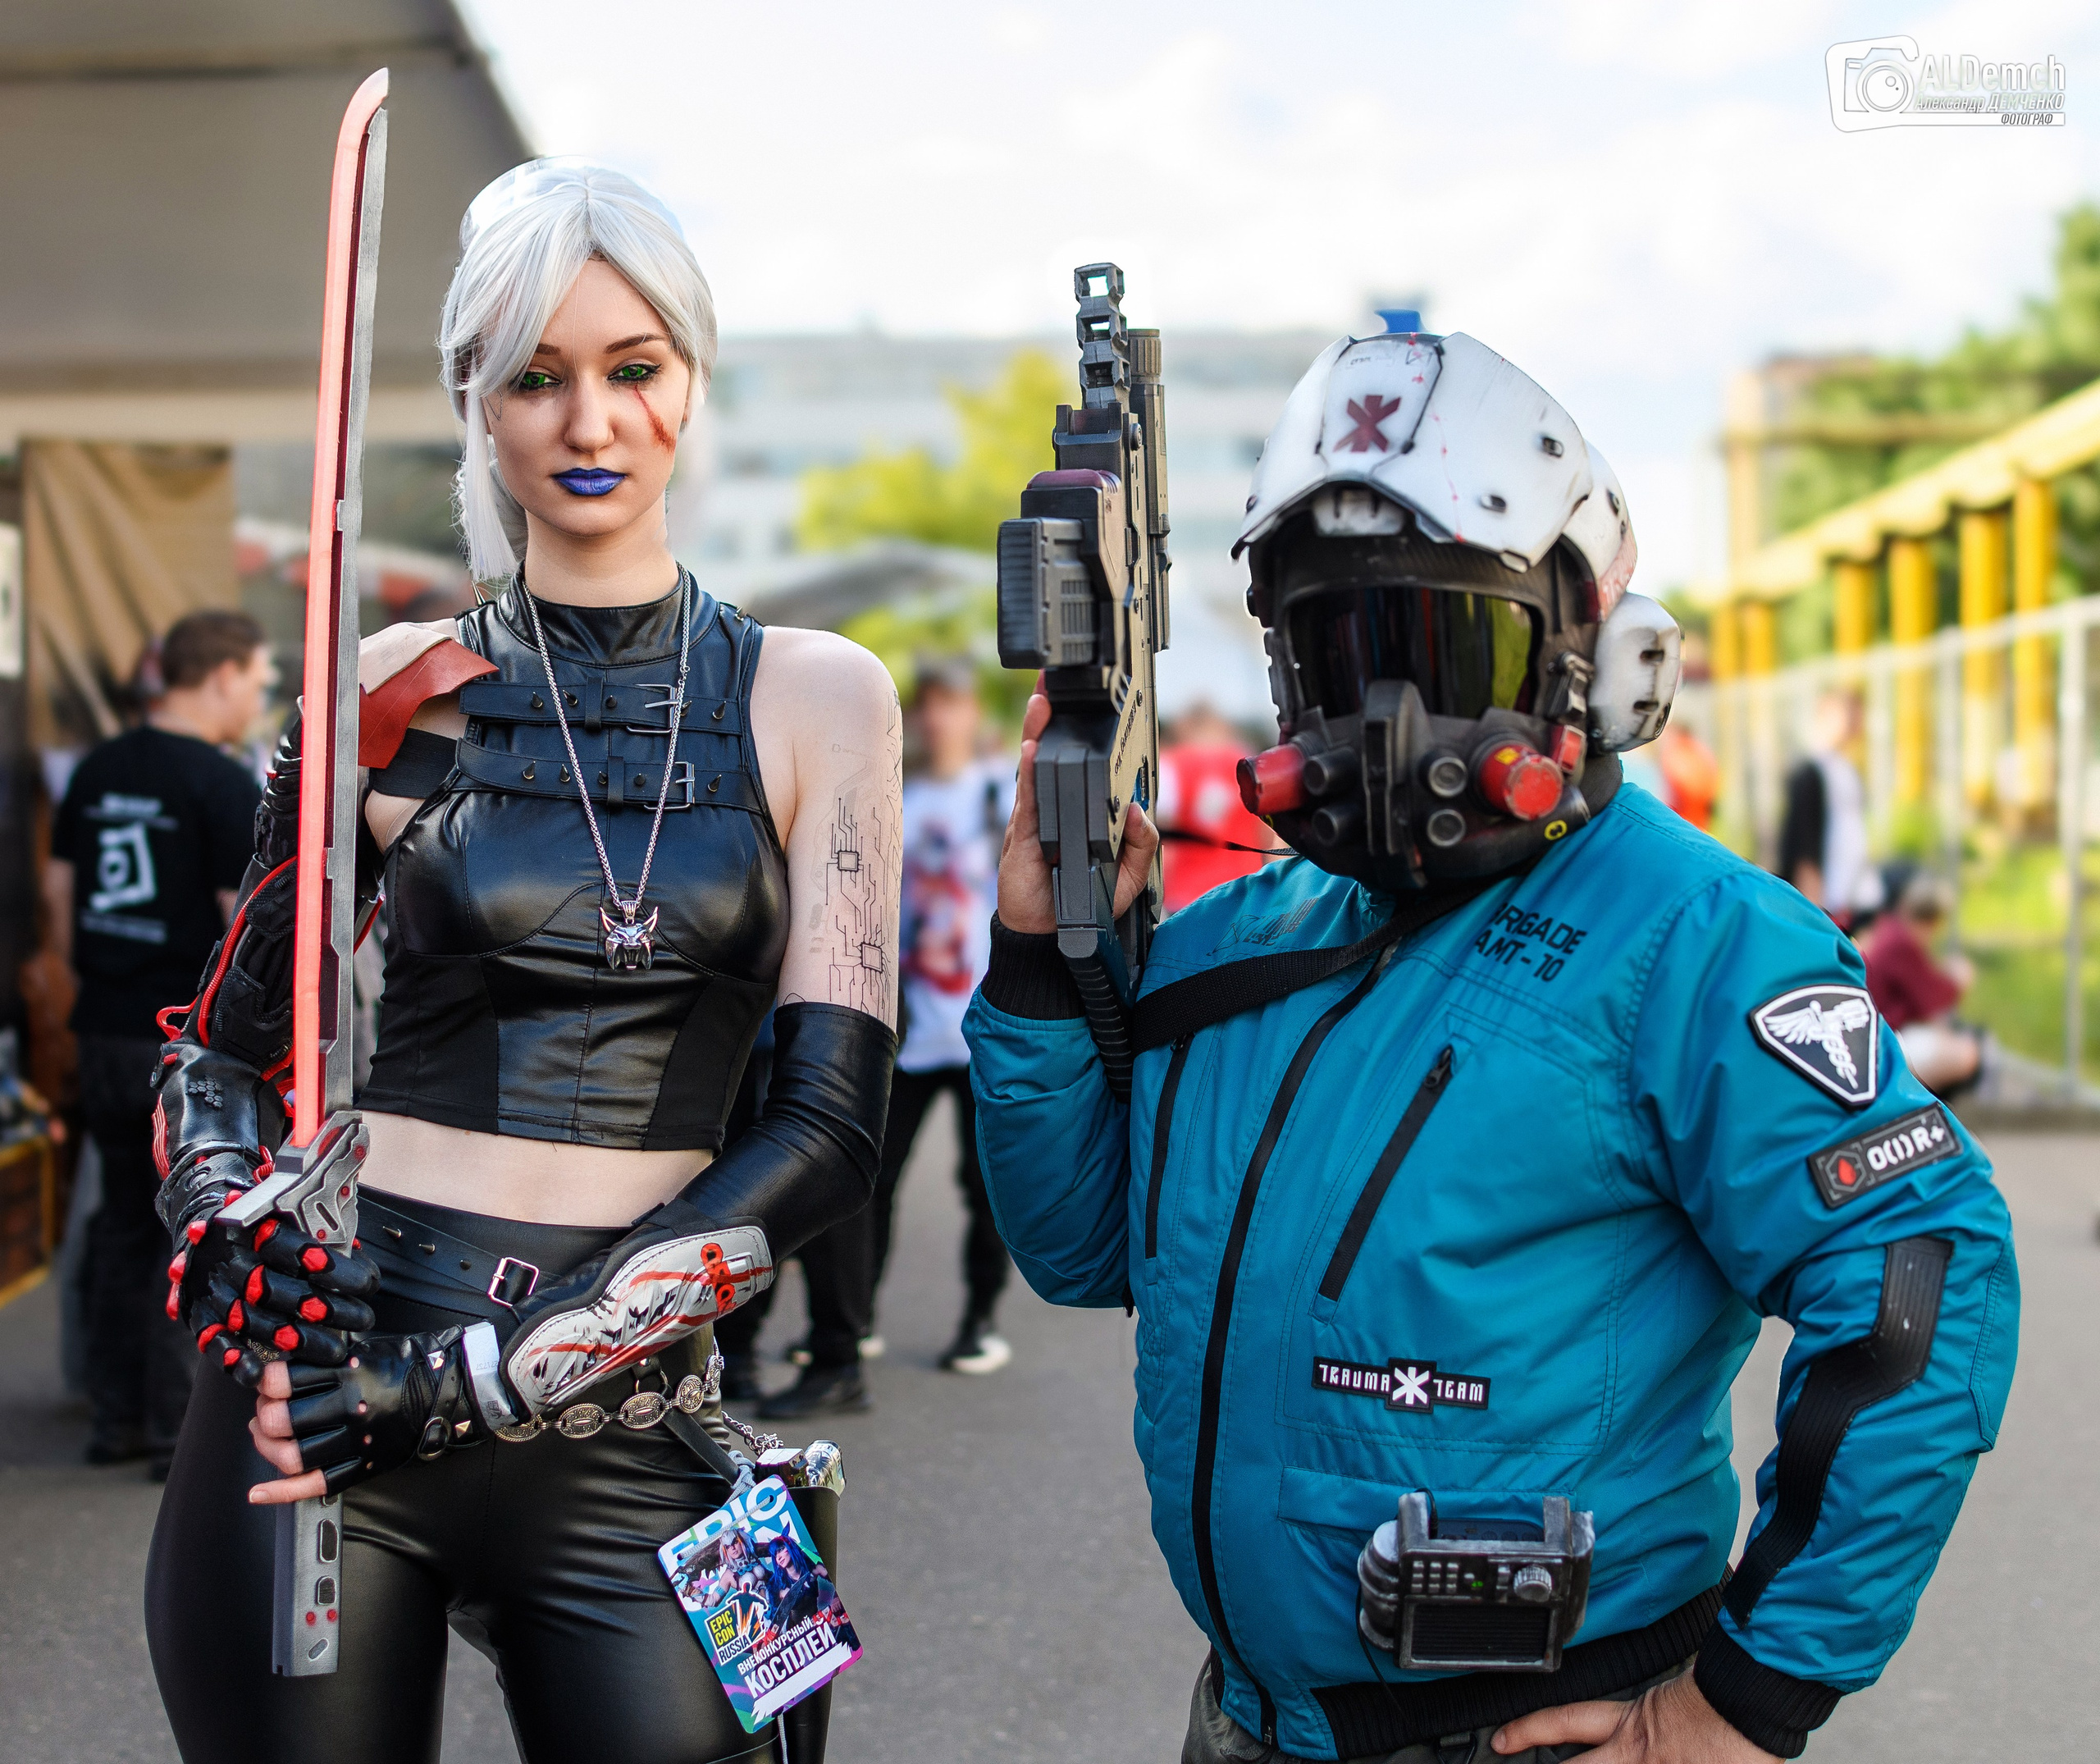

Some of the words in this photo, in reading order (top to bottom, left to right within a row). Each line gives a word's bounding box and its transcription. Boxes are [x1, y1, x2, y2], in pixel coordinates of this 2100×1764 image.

[1319, 1364, 1390, 1392] TRAUMA
[1433, 1378, 1483, 1402] TEAM
[710, 1610, 733, 1634] EPIC
[714, 1625, 736, 1646] CON
[719, 1634, 751, 1663] RUSSIA
[737, 1615, 813, 1675] ВНЕКОНКУРСНЫЙ
[744, 1617, 837, 1699] КОСПЛЕЙ
